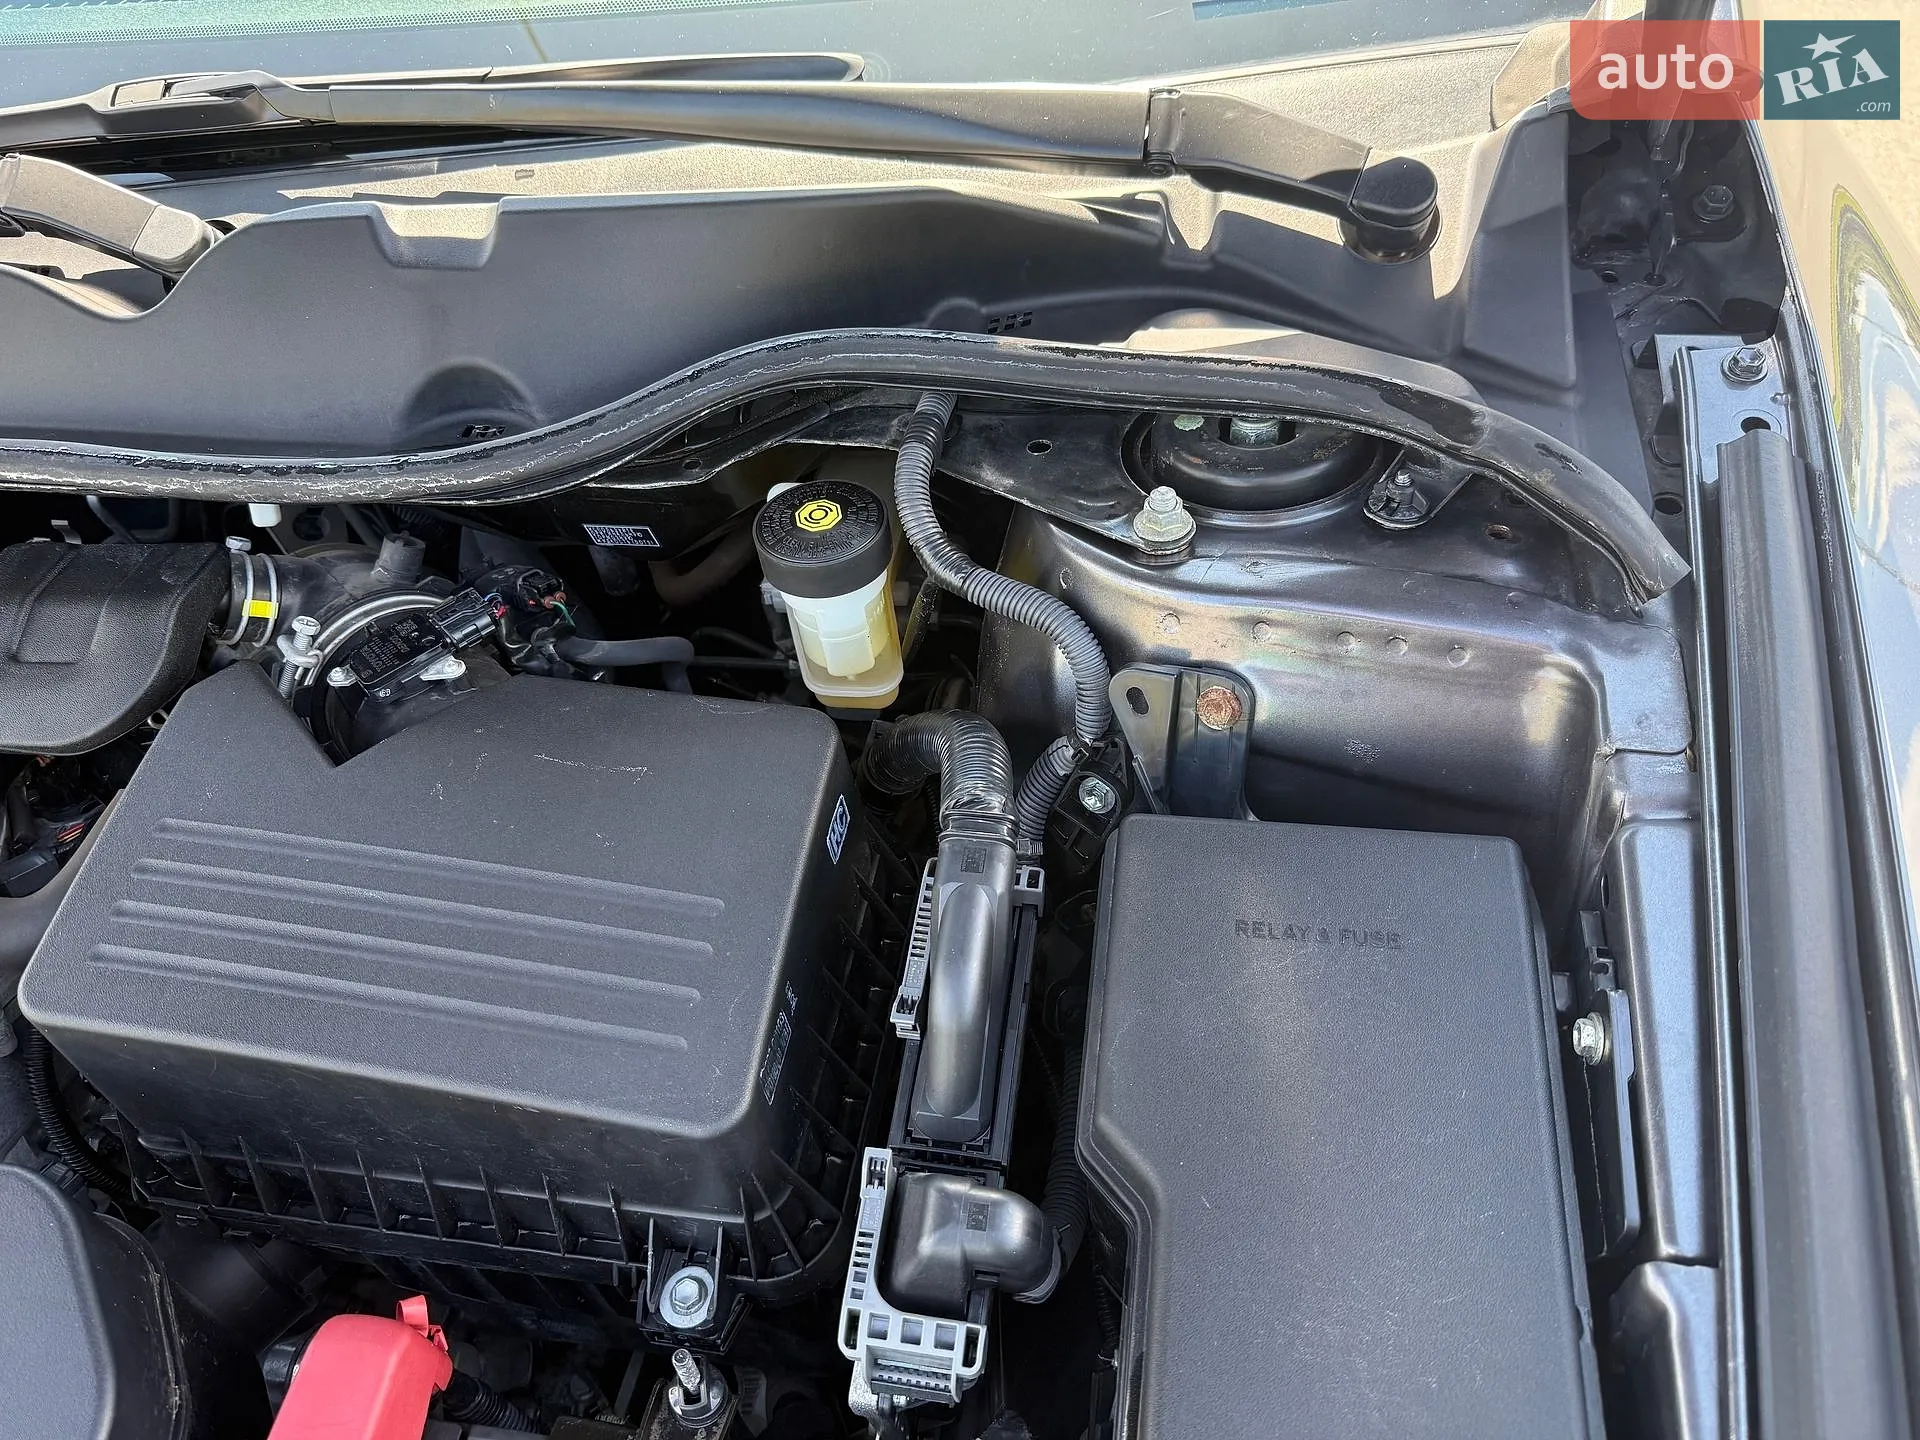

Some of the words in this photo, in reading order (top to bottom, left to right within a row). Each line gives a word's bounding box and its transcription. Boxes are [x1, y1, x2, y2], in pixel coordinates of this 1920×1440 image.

[1235, 919, 1311, 942] RELAY
[1316, 927, 1332, 945] &
[1338, 928, 1403, 950] FUSE
